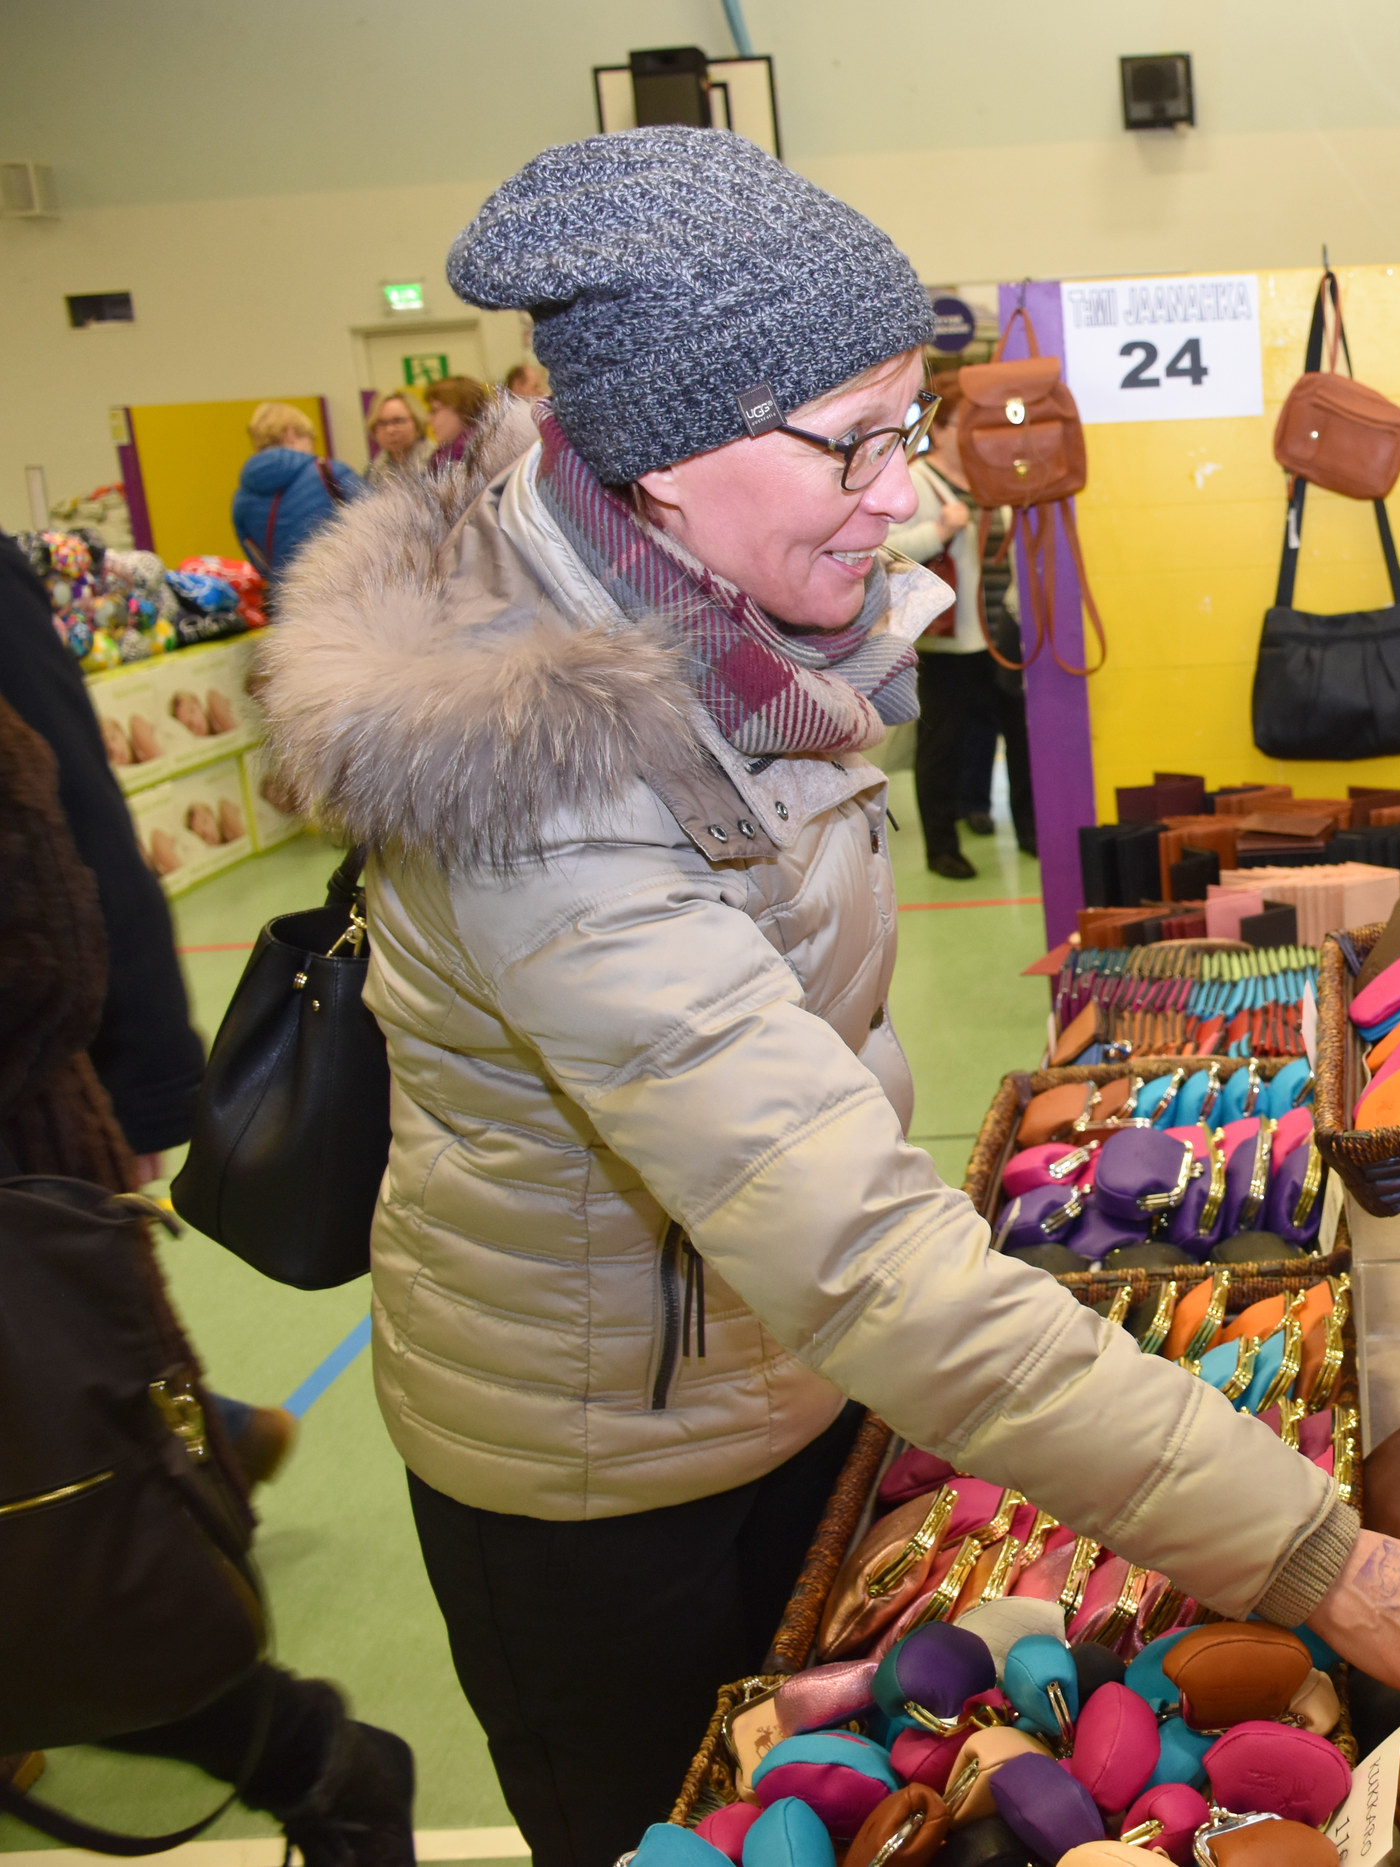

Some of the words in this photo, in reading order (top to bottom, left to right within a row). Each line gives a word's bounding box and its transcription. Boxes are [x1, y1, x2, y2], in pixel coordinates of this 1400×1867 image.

[1124, 281, 1252, 326] JAANAHKA
[1118, 338, 1209, 390] 24
[746, 402, 770, 419] UGG
[1360, 1755, 1381, 1857] KUKKARO
